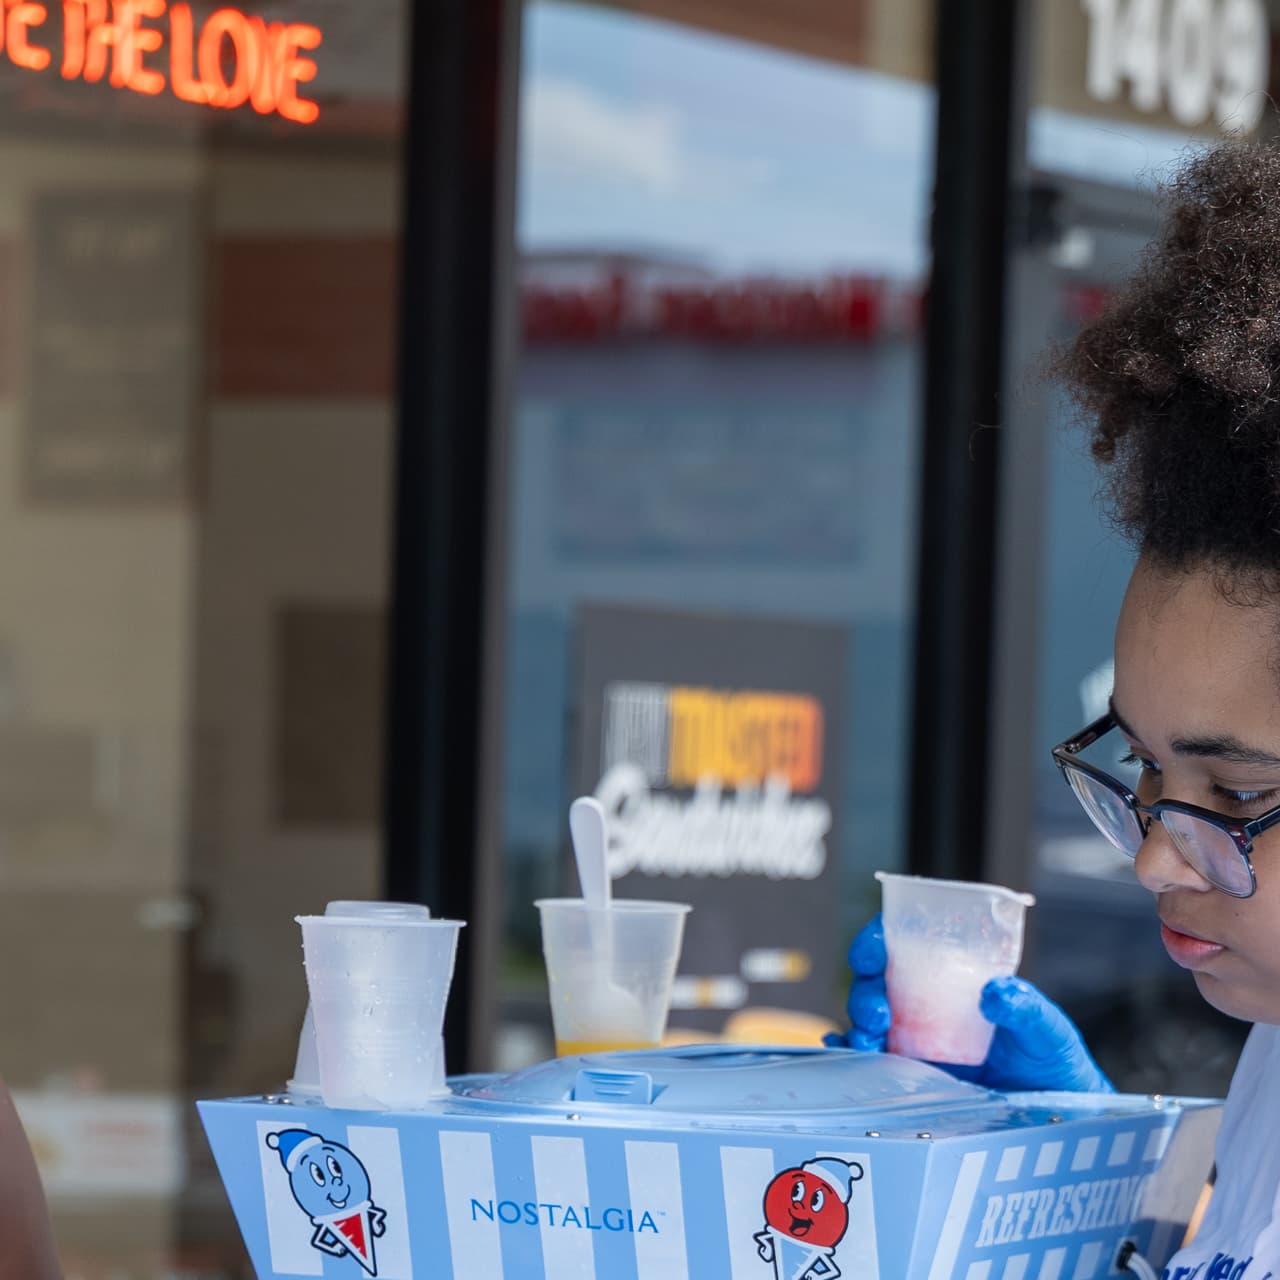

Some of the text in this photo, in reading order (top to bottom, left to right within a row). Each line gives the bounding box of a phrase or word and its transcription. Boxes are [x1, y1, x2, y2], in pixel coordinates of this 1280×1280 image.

[61, 0, 165, 95] THE
[170, 2, 322, 124] LOVE
[1081, 0, 1269, 136] 1409
[470, 1198, 659, 1234] NOSTALGIA
